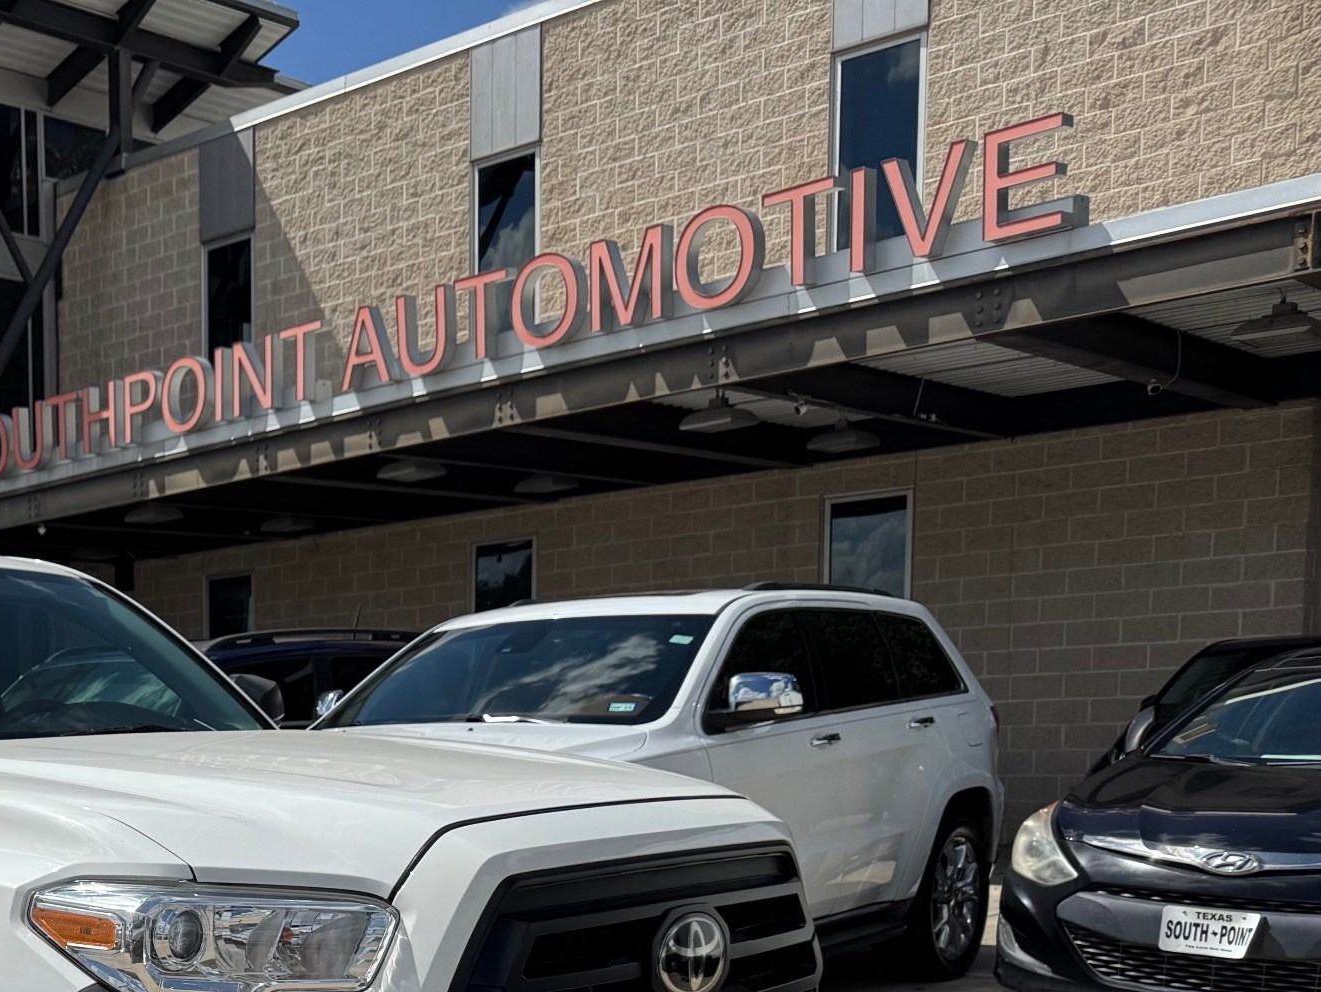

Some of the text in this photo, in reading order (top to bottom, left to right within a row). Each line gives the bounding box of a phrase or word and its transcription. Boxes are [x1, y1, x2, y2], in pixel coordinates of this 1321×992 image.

[341, 112, 1070, 391] AUTOMOTIVE
[1195, 911, 1233, 923] TEXAS
[1165, 920, 1254, 946] SOUTH POINT
